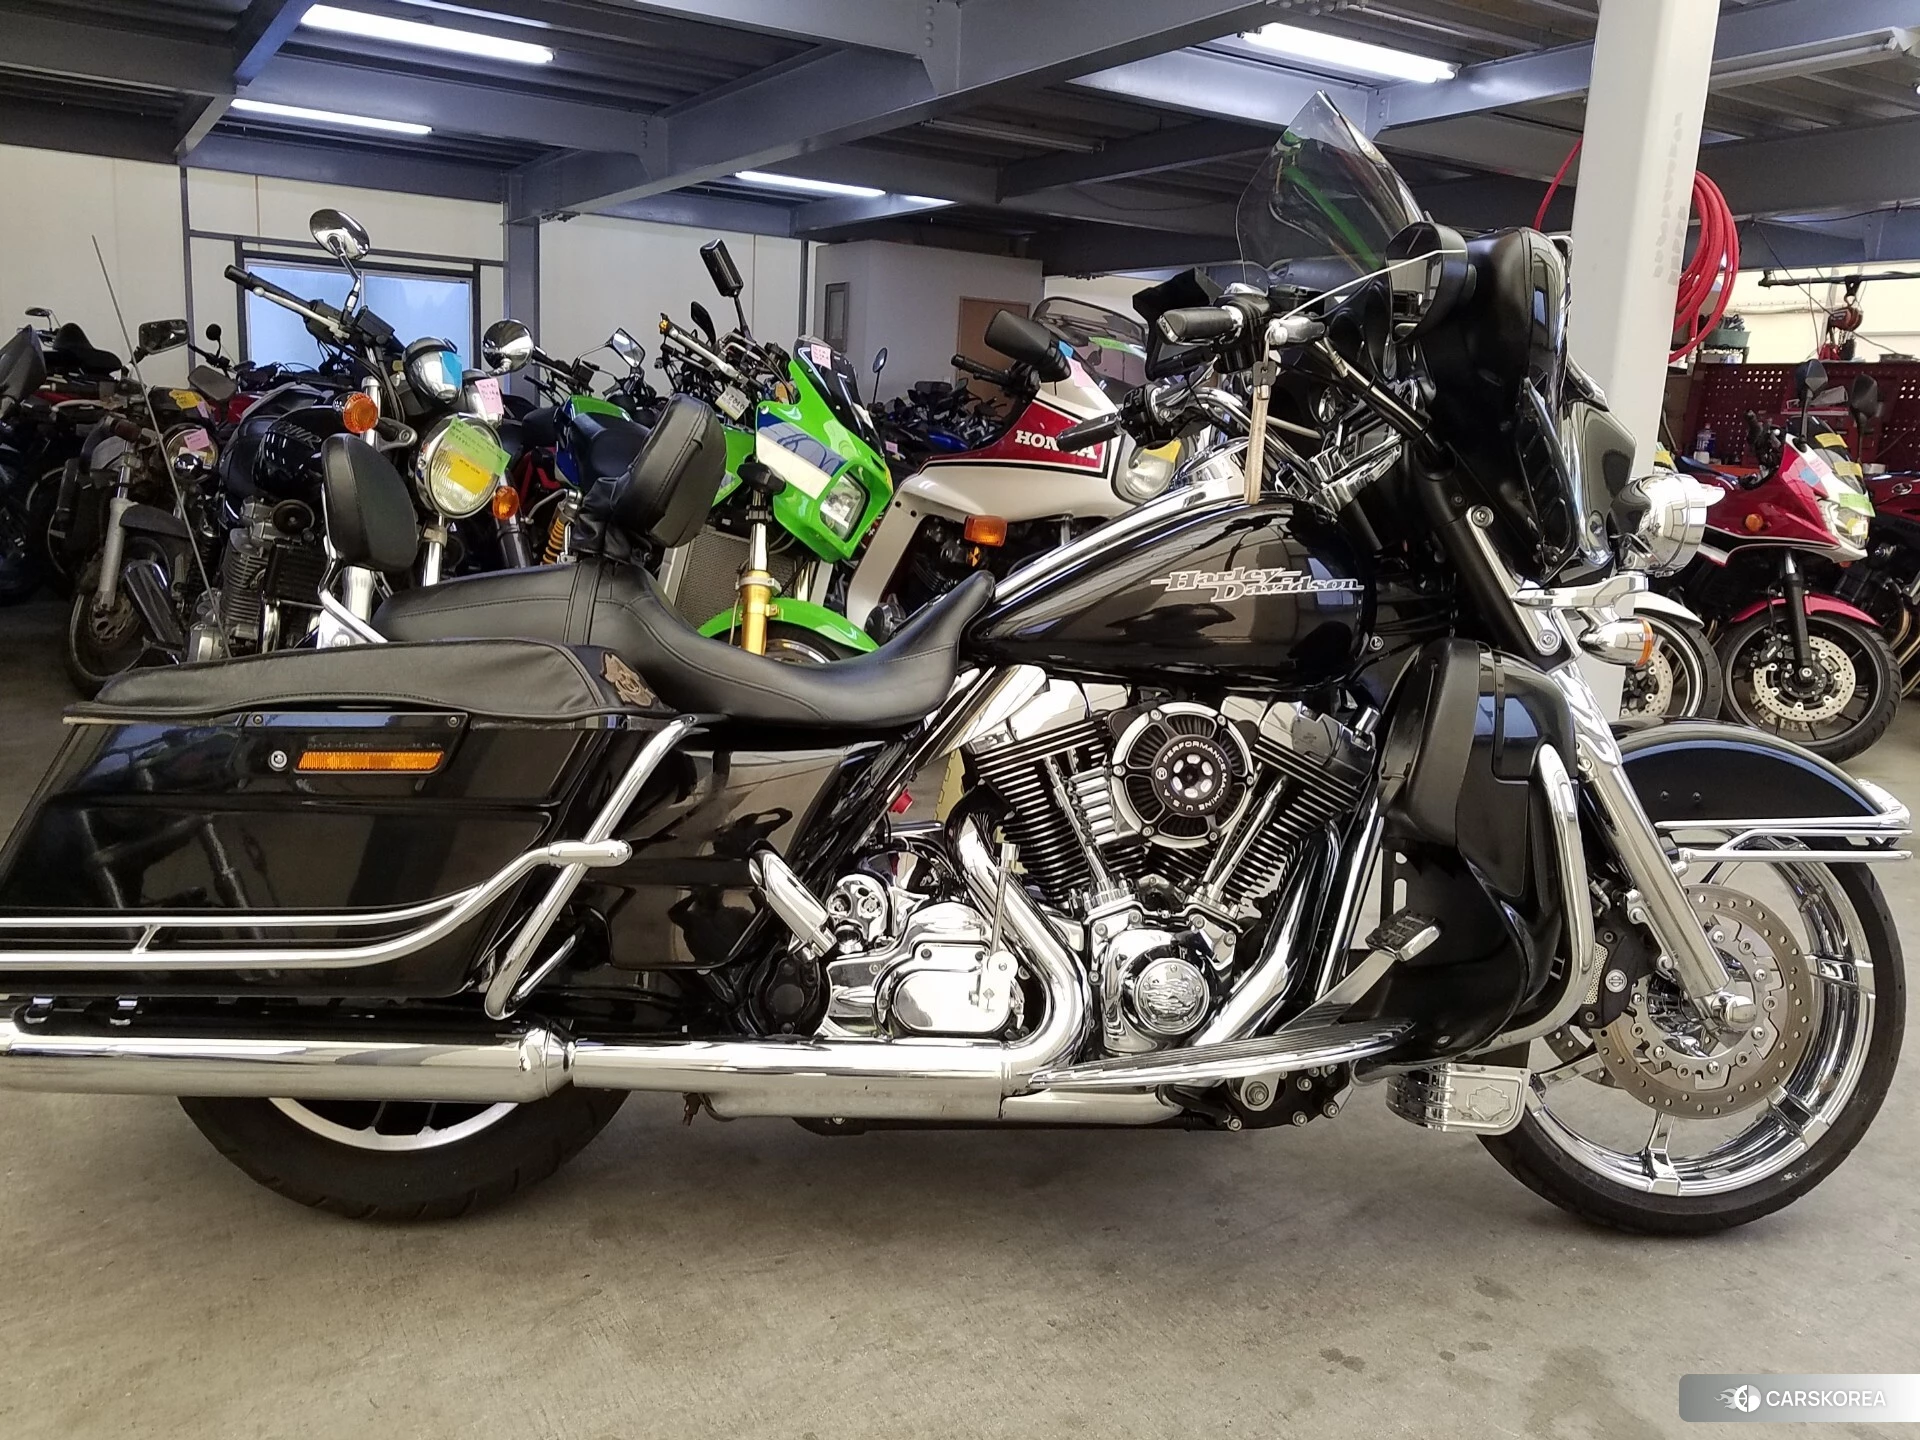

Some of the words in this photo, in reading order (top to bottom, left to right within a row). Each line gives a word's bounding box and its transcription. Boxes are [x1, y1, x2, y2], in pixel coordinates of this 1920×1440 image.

[1015, 430, 1097, 459] HONA
[1158, 567, 1294, 592] Harley
[1208, 576, 1365, 602] Davidson
[1163, 741, 1226, 771] PERFORMANCE
[1198, 773, 1227, 810] MACHINE
